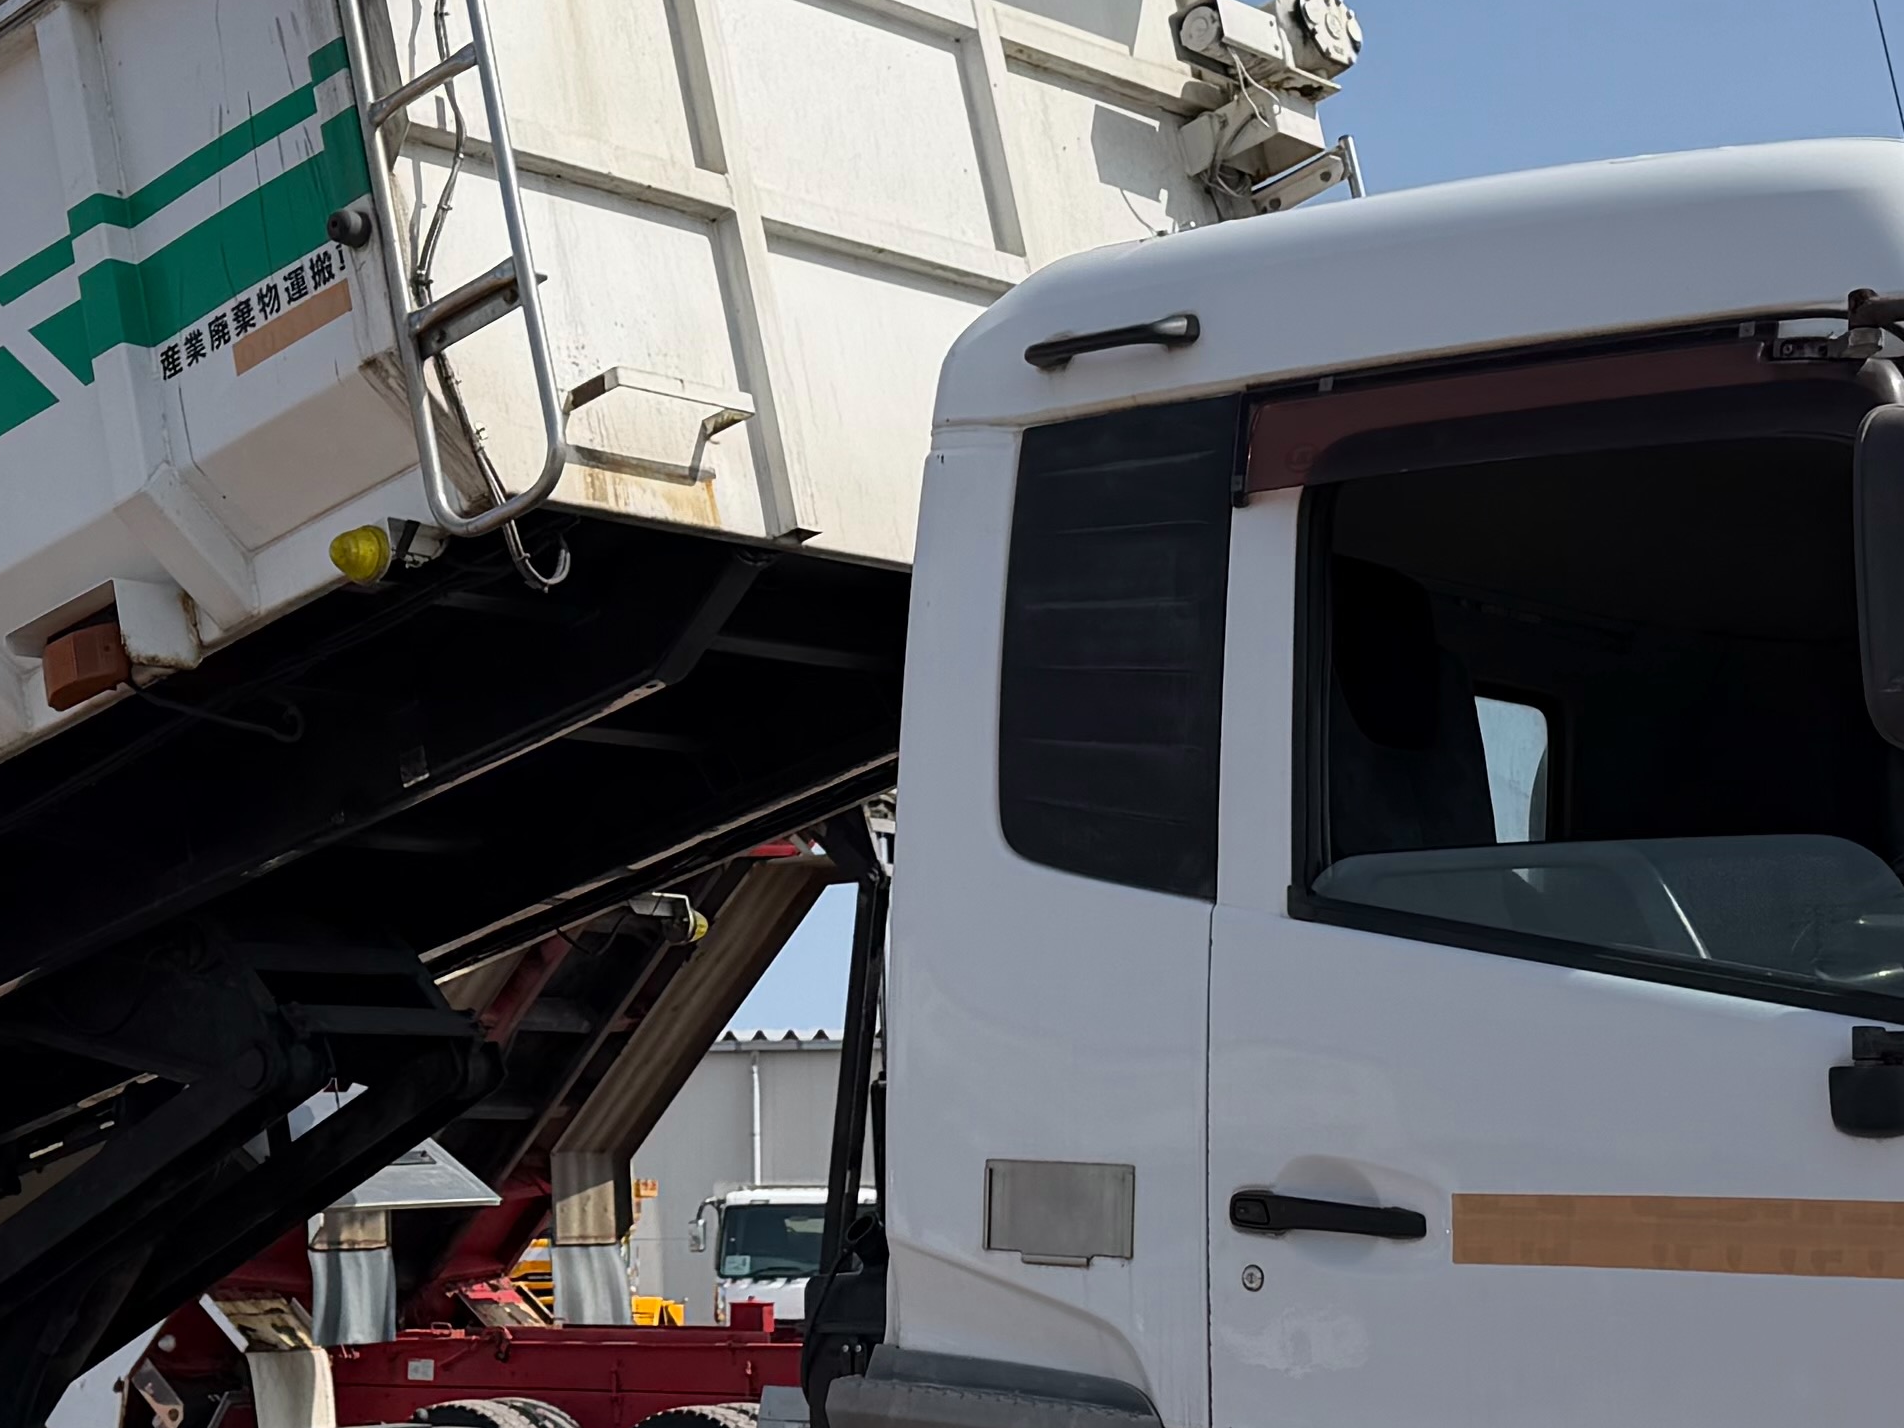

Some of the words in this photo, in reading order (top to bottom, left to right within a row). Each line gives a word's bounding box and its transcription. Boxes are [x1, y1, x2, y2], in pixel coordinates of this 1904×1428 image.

[159, 243, 346, 381] 産業廃棄物運搬
